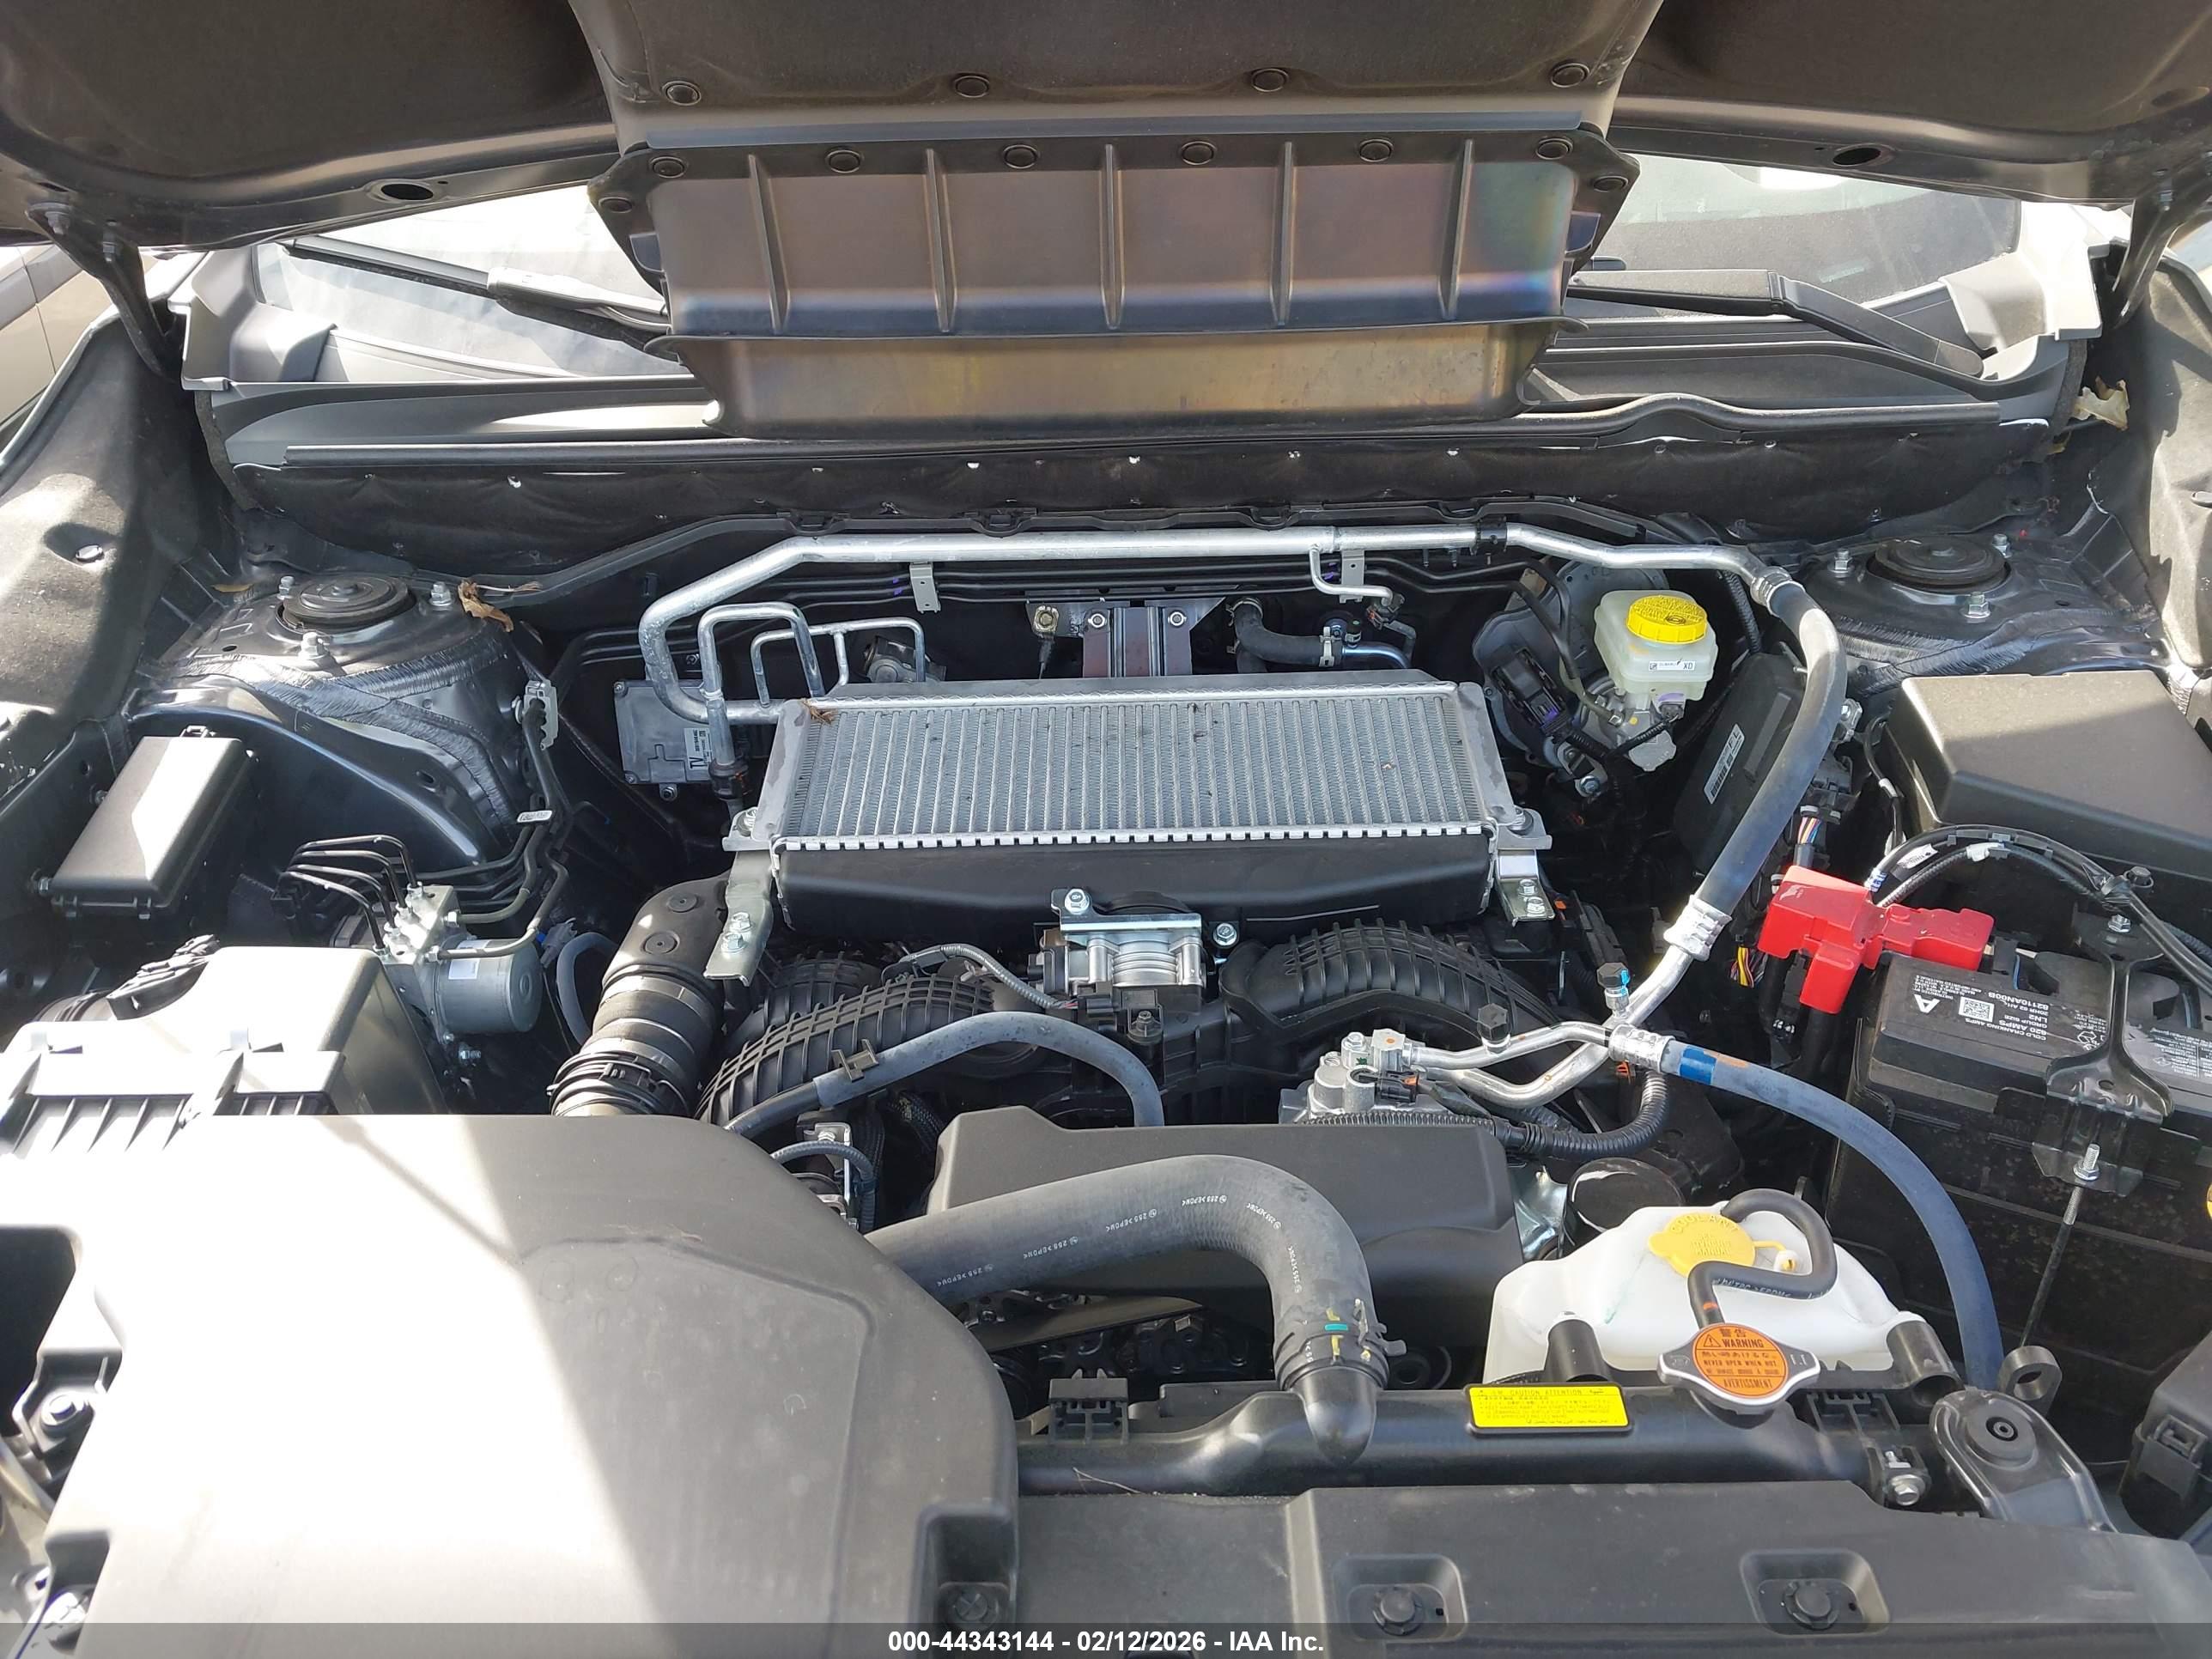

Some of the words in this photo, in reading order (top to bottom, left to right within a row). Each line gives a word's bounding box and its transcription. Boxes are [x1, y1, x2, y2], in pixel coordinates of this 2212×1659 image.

[2028, 1013, 2048, 1024] LN2
[1986, 1023, 2025, 1036] CRANKING
[1998, 1019, 2028, 1030] AMPS
[2026, 1032, 2046, 1041] COLD
[1722, 1339, 1765, 1348] WARNING
